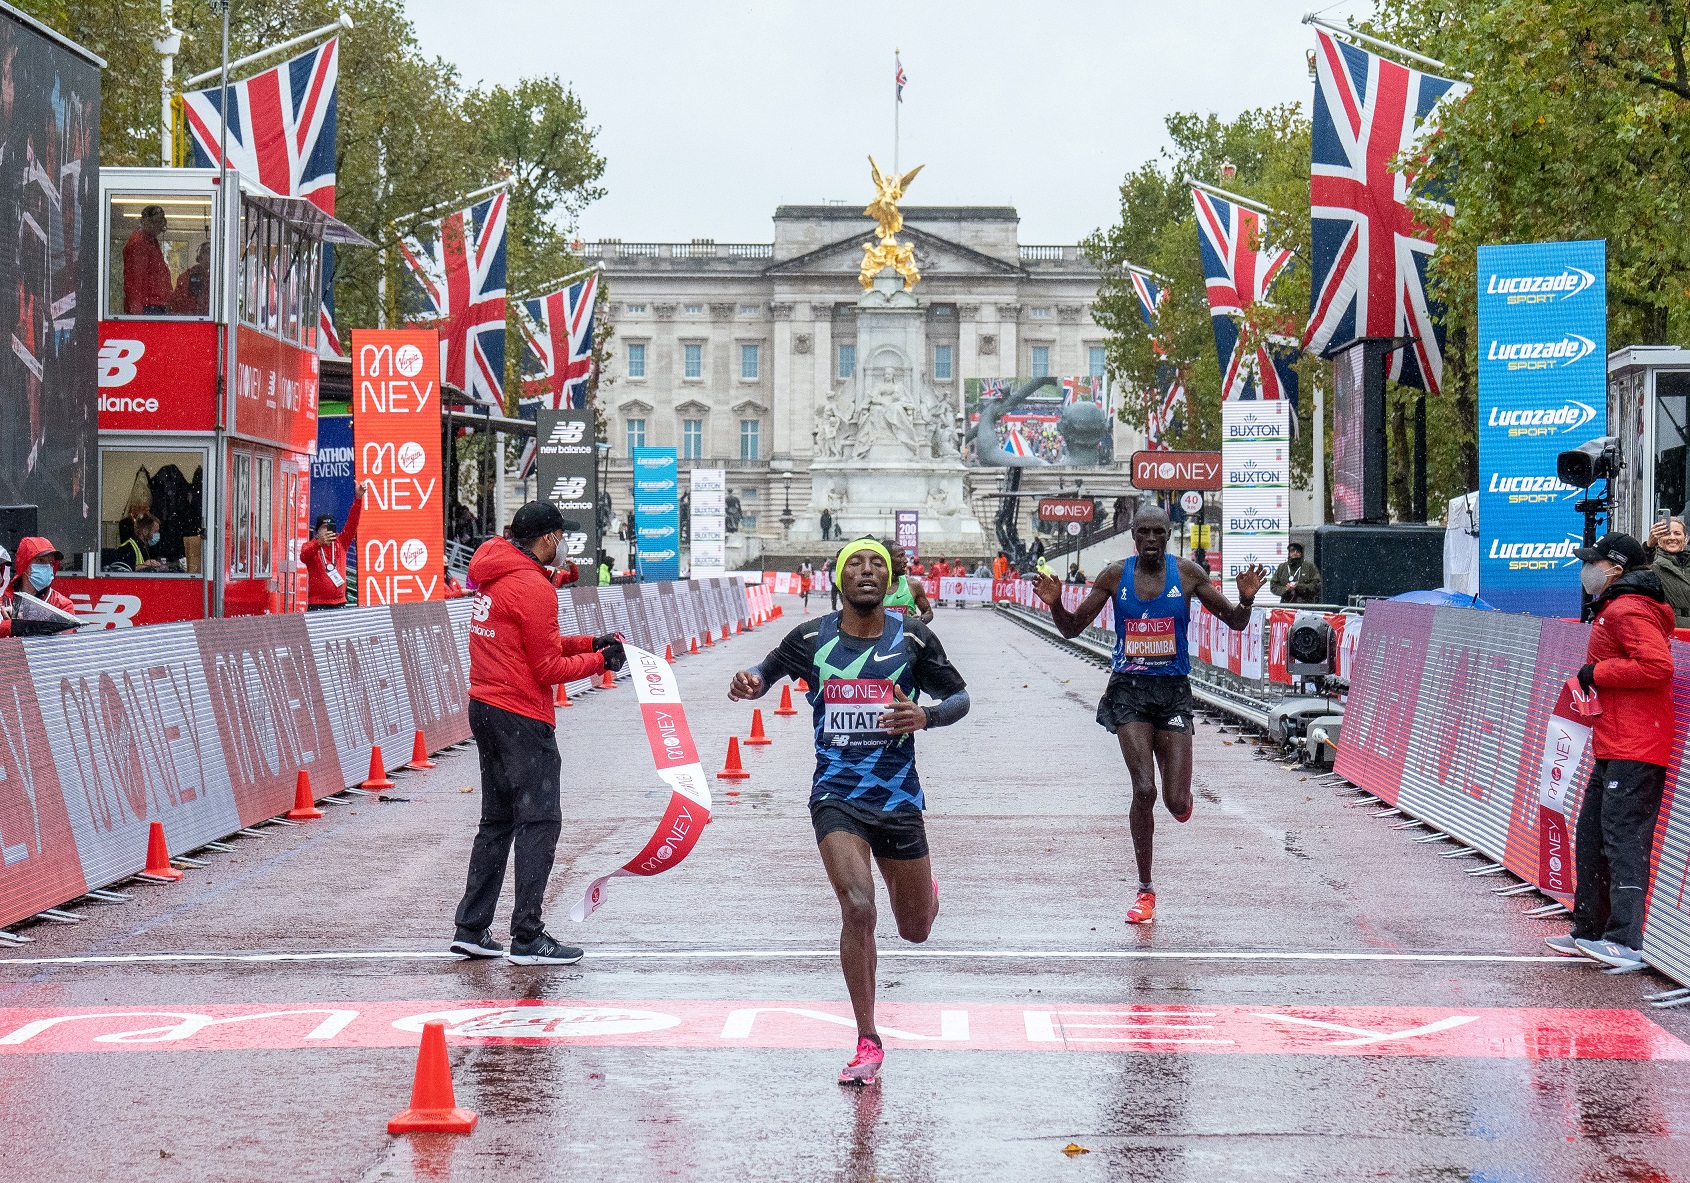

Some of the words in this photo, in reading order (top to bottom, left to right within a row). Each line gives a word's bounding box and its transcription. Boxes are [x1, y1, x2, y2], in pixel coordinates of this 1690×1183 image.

[1487, 271, 1579, 294] Lucozade
[1507, 294, 1557, 304] SPORT
[1487, 338, 1580, 360] Lucozade
[98, 339, 146, 388] B
[1507, 360, 1557, 370] SPORT
[98, 393, 159, 413] lance
[1488, 404, 1581, 426] Lucozade
[1230, 425, 1280, 437] BUXTON
[1508, 427, 1558, 437] SPORT
[540, 446, 557, 454] new
[557, 445, 592, 454] balance
[313, 462, 350, 478] EVENTS
[1137, 461, 1219, 480] MONEY
[1230, 471, 1280, 483] BUXTON
[559, 501, 593, 510] balance
[1185, 496, 1198, 504] 40
[1508, 494, 1558, 504] SPORT
[1042, 504, 1091, 517] MONEY
[899, 523, 917, 535] 200
[1230, 519, 1280, 530] BUXTON
[1509, 560, 1558, 570] SPORT
[944, 581, 987, 596] MONEY
[1127, 621, 1172, 633] MONEY
[1126, 639, 1175, 655] KIPCHUMBA
[638, 651, 665, 695] MONEY
[325, 633, 401, 750] MONEY
[826, 684, 889, 699] MONEY
[215, 644, 321, 784] MONEY
[655, 710, 684, 760] MONEY
[60, 662, 206, 832] MONEY
[1547, 728, 1572, 800] MONEY
[641, 805, 693, 871] MONEY
[1548, 818, 1562, 890] MONEY
[0, 1006, 1480, 1046] MONEY
